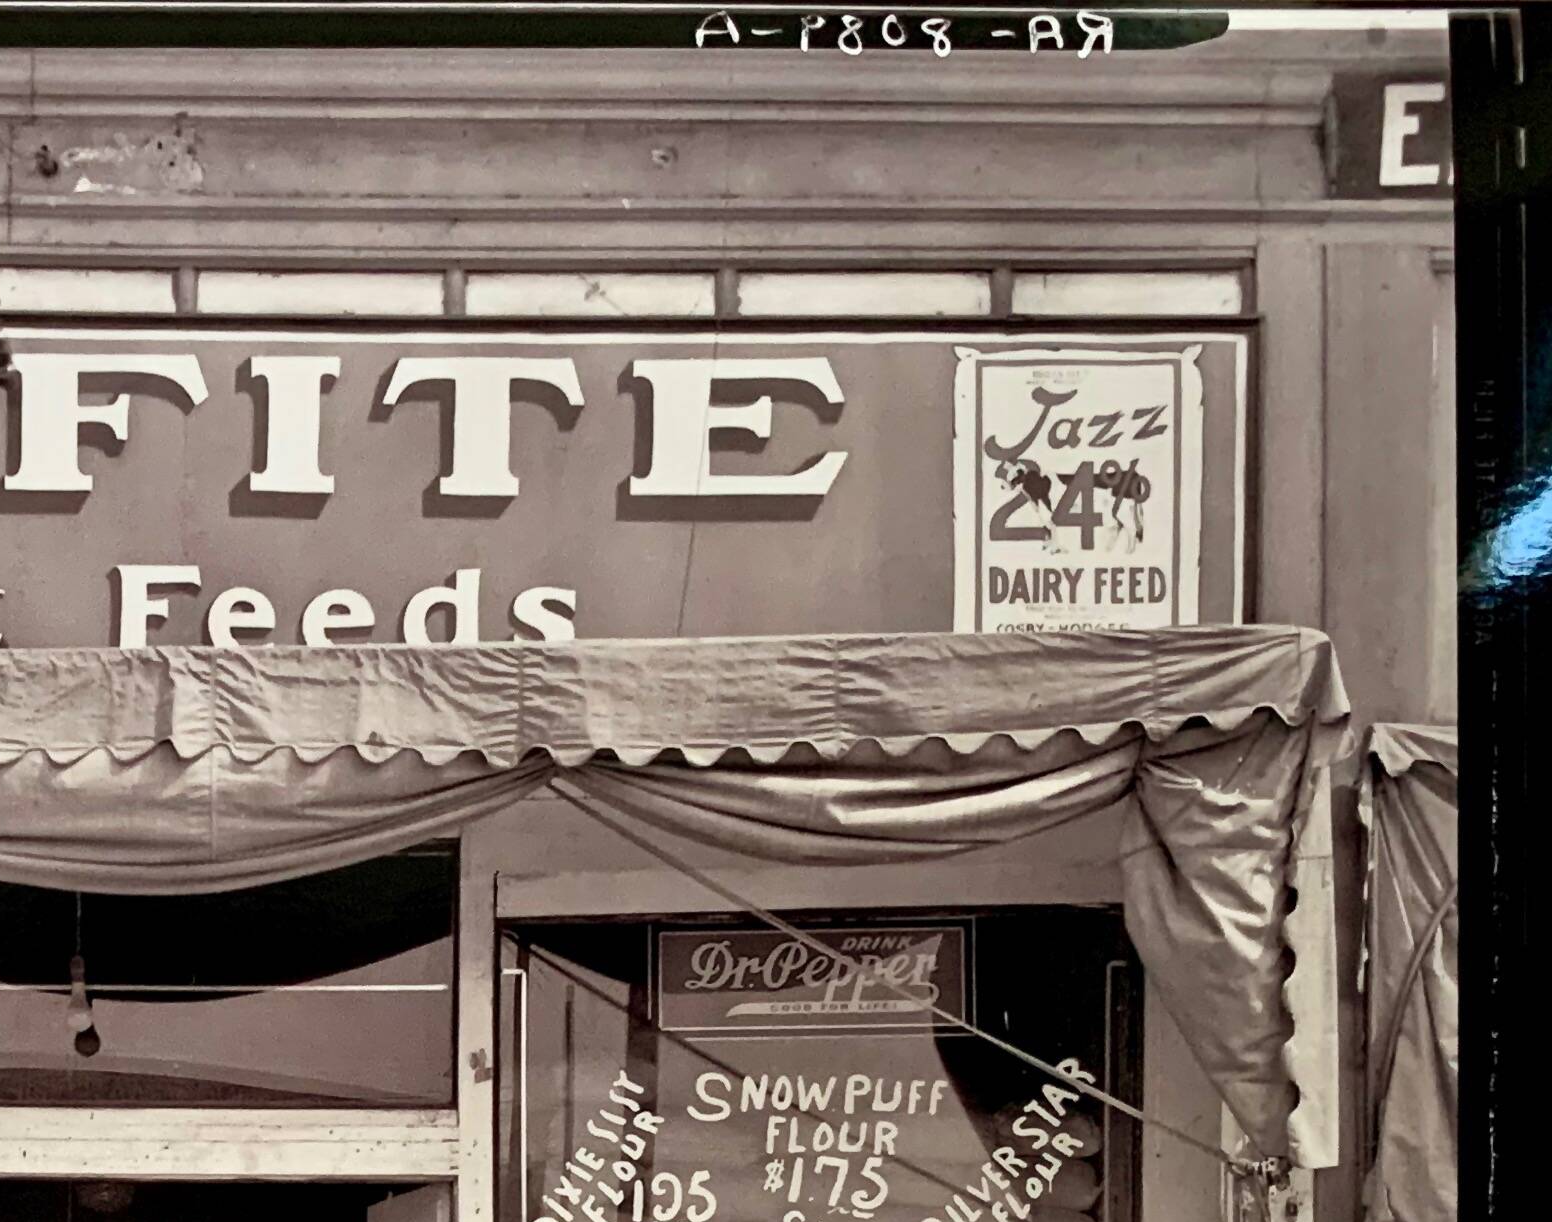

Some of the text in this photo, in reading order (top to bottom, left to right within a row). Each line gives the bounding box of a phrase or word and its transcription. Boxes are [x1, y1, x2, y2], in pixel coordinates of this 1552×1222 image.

[4, 353, 848, 496] FITE
[984, 386, 1168, 460] Jazz
[989, 457, 1151, 550] 24%
[118, 564, 577, 650] Feeds
[989, 565, 1167, 605] DAIRY FEED
[842, 936, 914, 950] DRINK
[844, 1073, 949, 1116] PUFF
[1012, 1058, 1097, 1150] STAR
[766, 1115, 898, 1156] FLOUR
